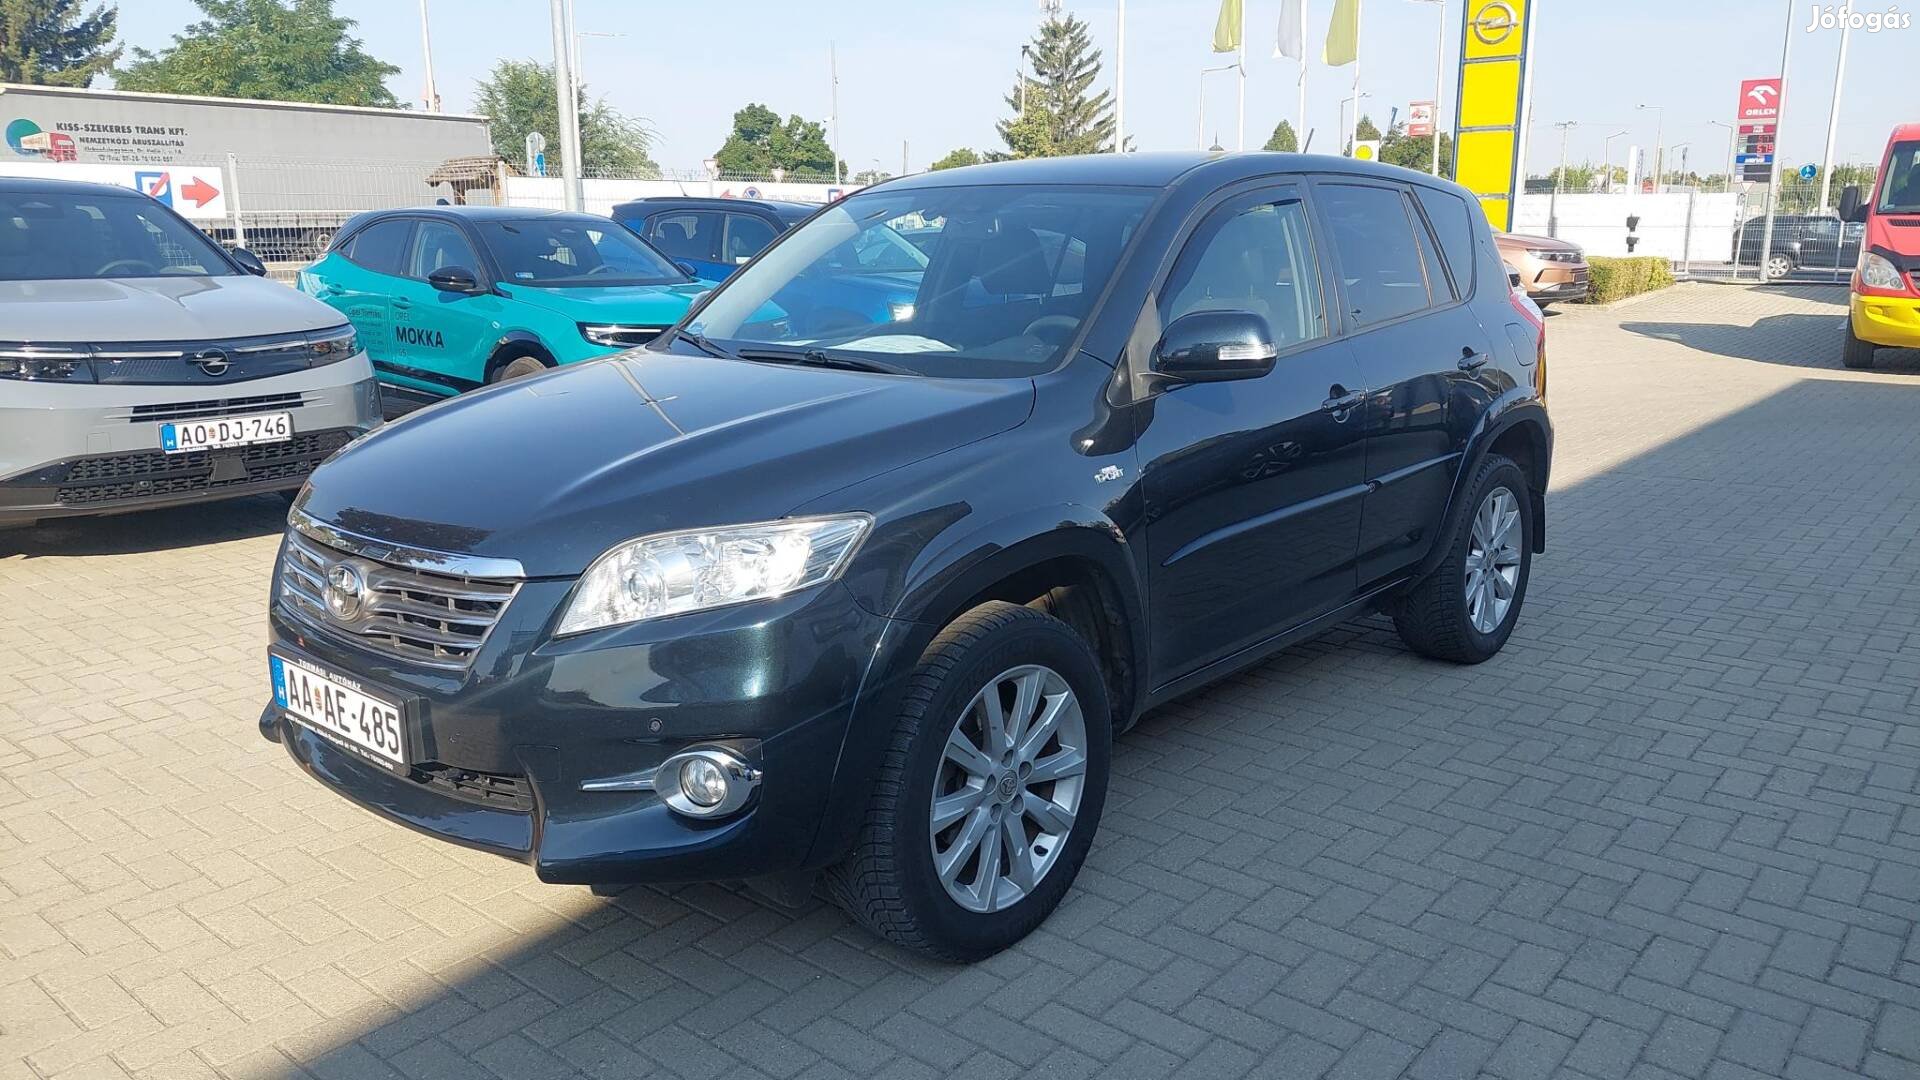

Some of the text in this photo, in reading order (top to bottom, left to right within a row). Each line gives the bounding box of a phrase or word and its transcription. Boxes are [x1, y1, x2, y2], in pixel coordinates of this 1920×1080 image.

[1746, 108, 1776, 116] ORLEN
[56, 122, 188, 136] KISS-SZEKERES TRANS KFT.
[396, 326, 444, 348] MOKKA
[181, 425, 207, 446] AO
[219, 417, 286, 441] DJ-746
[289, 669, 314, 716] AA
[324, 685, 399, 755] AE-485
